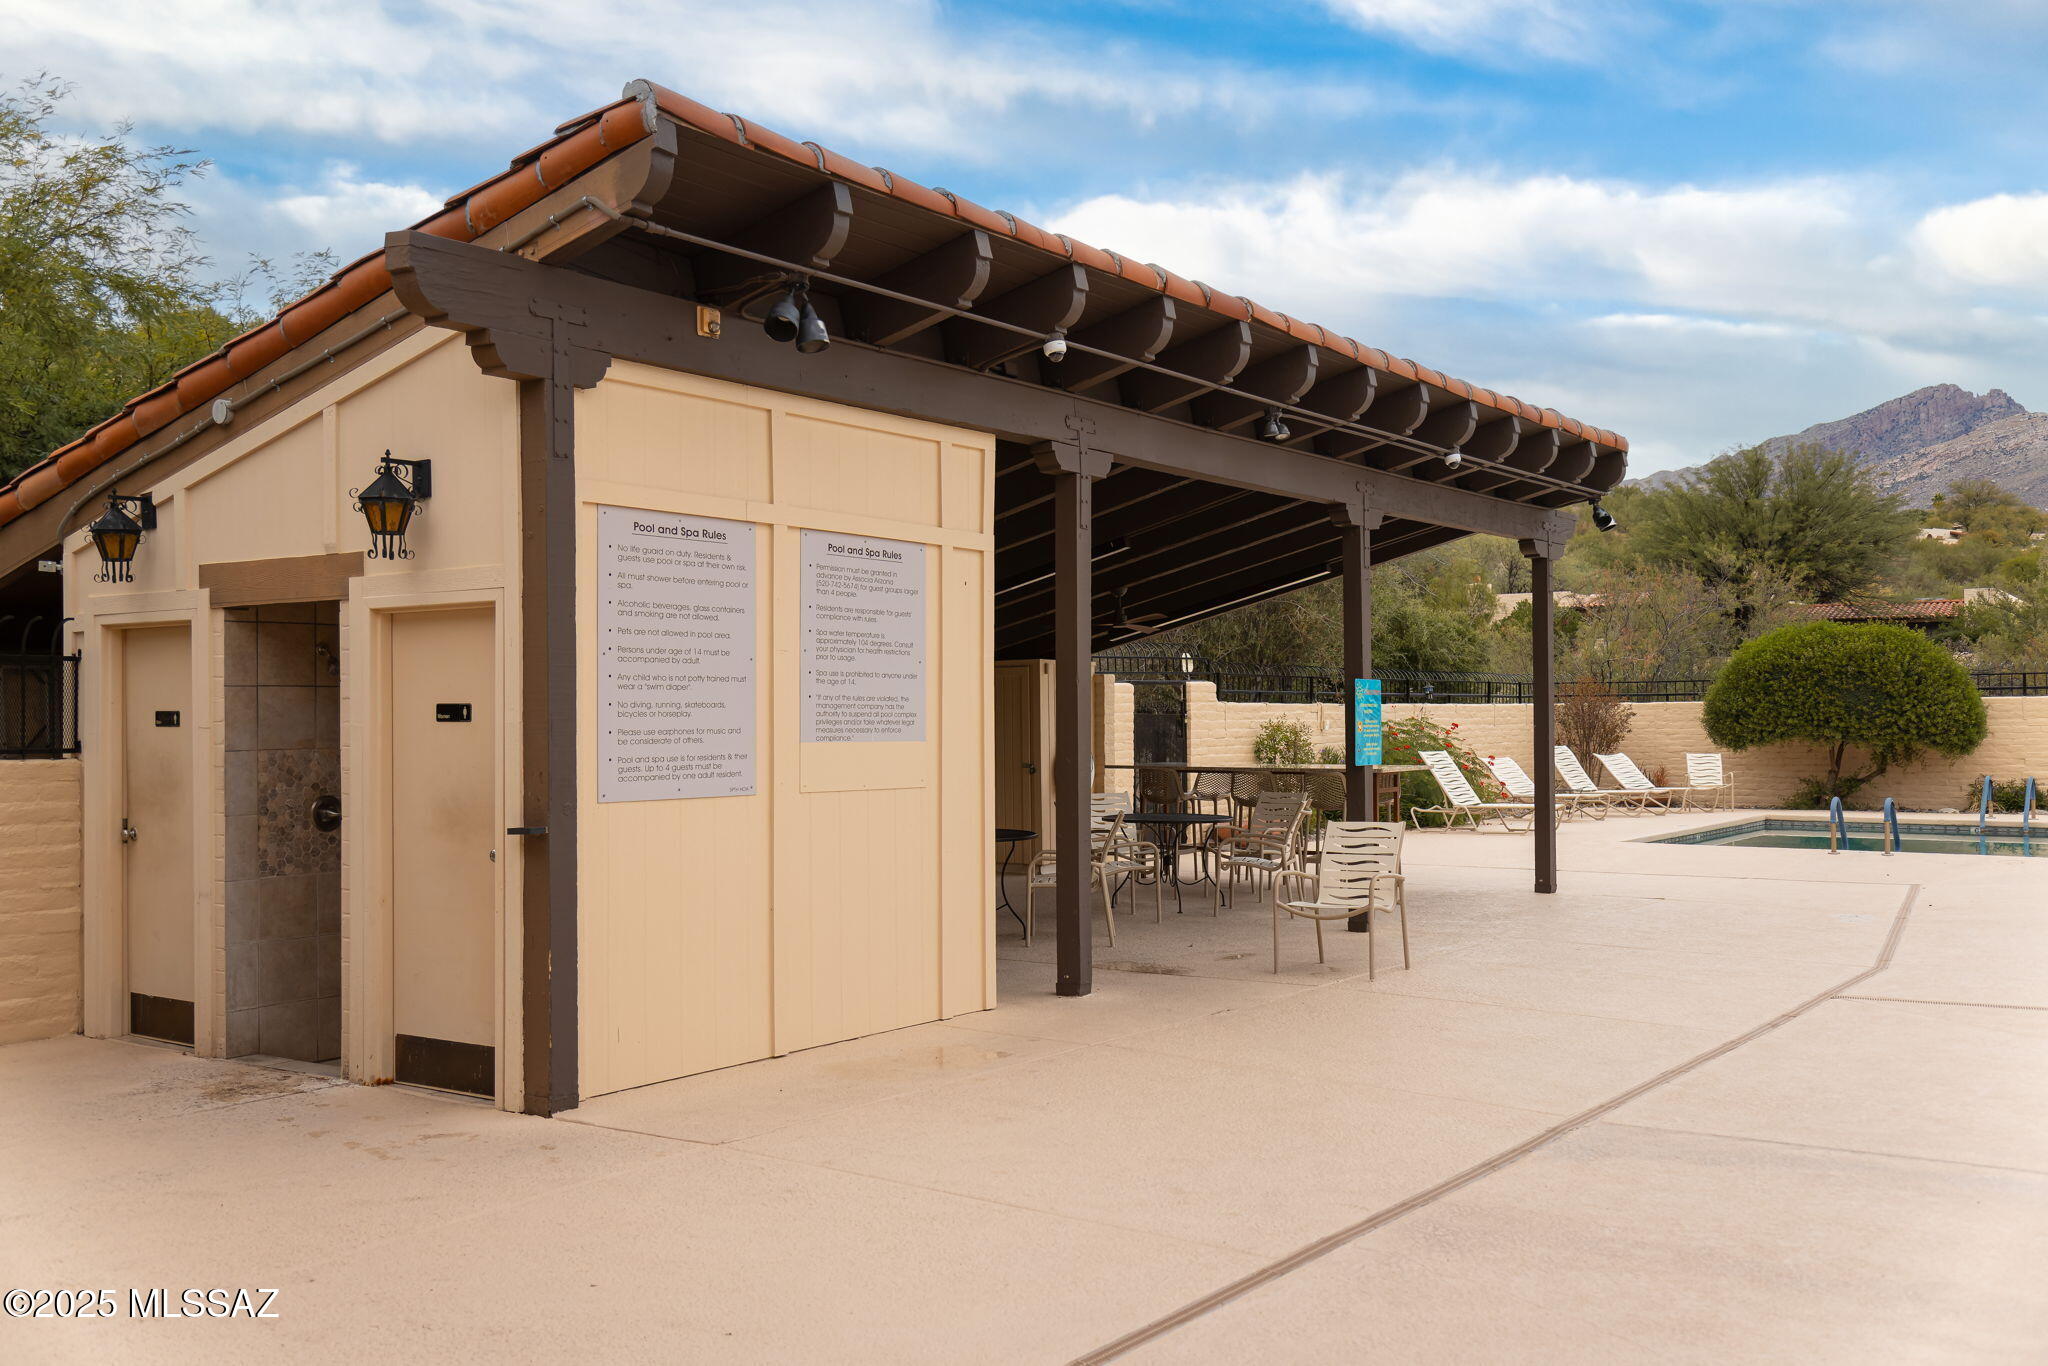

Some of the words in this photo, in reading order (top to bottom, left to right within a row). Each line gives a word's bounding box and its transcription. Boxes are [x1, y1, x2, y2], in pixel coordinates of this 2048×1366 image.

[633, 522, 655, 533] Pool
[658, 525, 677, 535] and
[681, 527, 699, 538] Spa
[702, 530, 727, 541] Rules
[617, 544, 628, 552] No
[630, 545, 640, 553] life
[642, 547, 663, 555] guard
[694, 551, 724, 561] Residents
[828, 544, 845, 553] Pool
[847, 547, 863, 555] and
[865, 548, 880, 558] Spa
[883, 550, 902, 560] Rules
[617, 554, 641, 562] guests
[706, 561, 720, 569] their
[646, 574, 672, 583] shower
[673, 577, 695, 585] before
[697, 579, 724, 588] entering
[726, 581, 740, 589] pool
[617, 600, 650, 609] Alcoholic
[652, 602, 691, 612] beverages,
[693, 605, 710, 613] glass
[711, 606, 745, 614] containers
[635, 611, 664, 620] smoking
[617, 627, 632, 635] Pets
[617, 646, 644, 654] Persons
[646, 647, 666, 655] under
[617, 656, 670, 664] accompanied
[671, 657, 680, 665] by
[617, 674, 631, 682] Any
[687, 675, 705, 683] potty
[706, 675, 729, 683] trained
[618, 701, 628, 709] No
[630, 701, 652, 710] diving,
[655, 702, 682, 710] running,
[618, 711, 647, 719] bicycles
[657, 729, 694, 737] earphones
[618, 738, 628, 746] be
[629, 737, 672, 745] considerate
[618, 756, 633, 764] Pool
[652, 756, 664, 764] spa
[680, 754, 685, 762] is
[644, 765, 654, 773] Up
[671, 764, 693, 772] guests
[618, 773, 670, 782] accompanied
[672, 773, 680, 781] by
